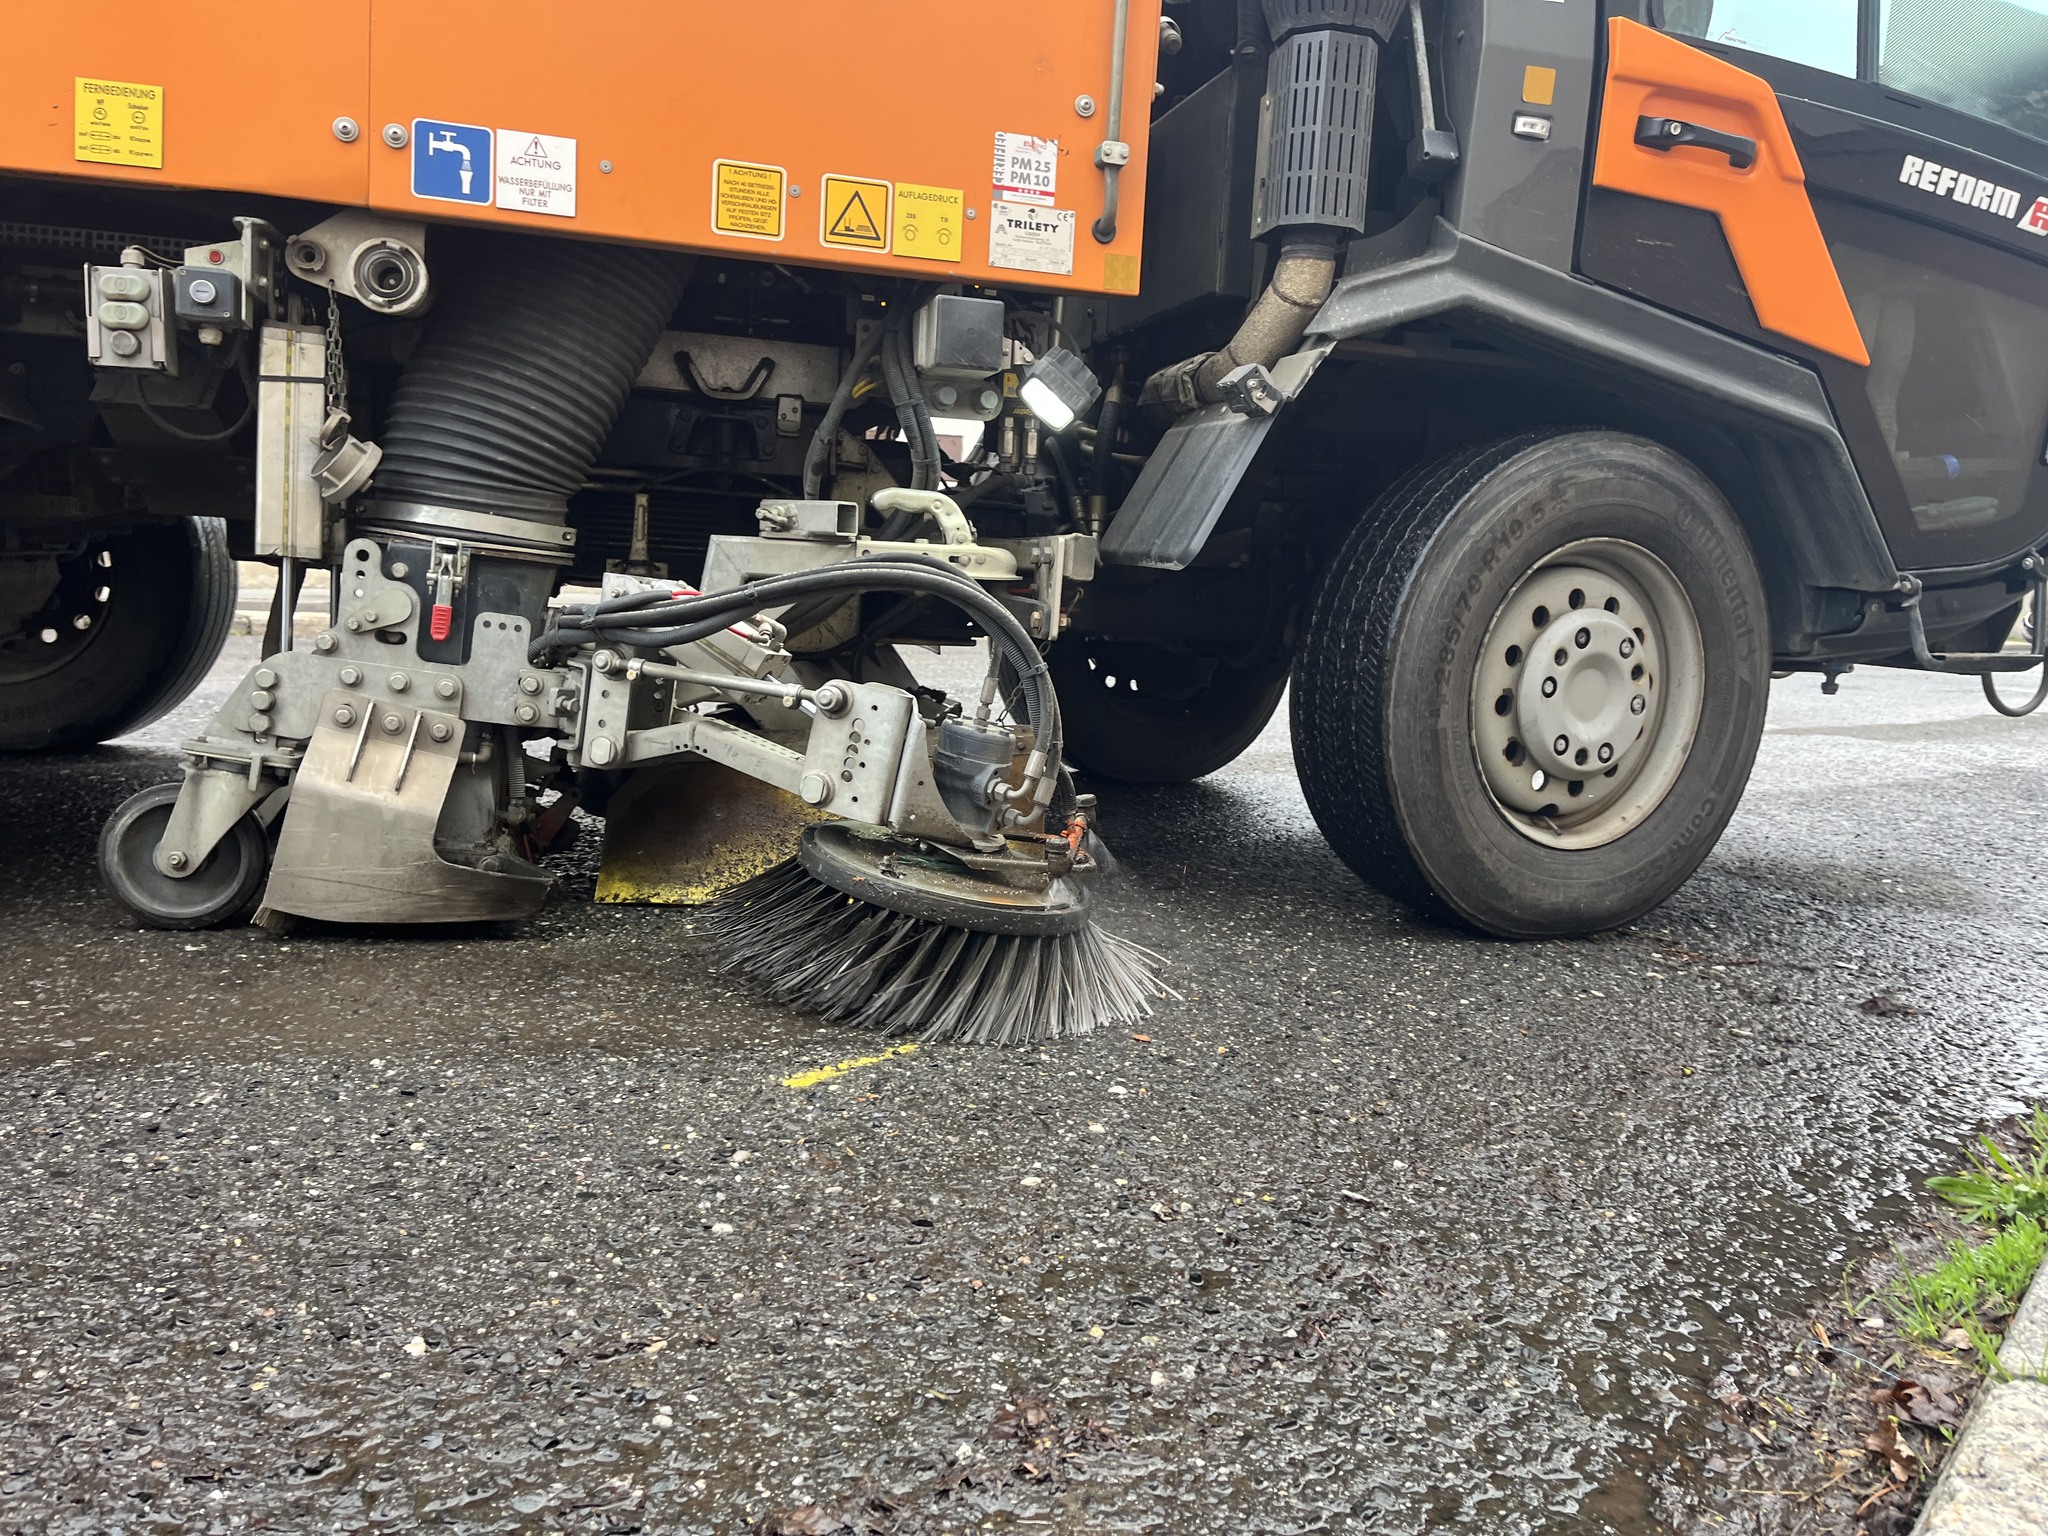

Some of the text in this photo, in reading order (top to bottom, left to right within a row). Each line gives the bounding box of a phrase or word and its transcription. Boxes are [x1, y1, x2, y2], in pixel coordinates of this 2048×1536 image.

[83, 82, 157, 100] FERNBEDIENUNG
[510, 156, 562, 170] ACHTUNG
[1010, 156, 1051, 173] PM 2.5
[732, 169, 768, 179] ACHTUNG
[1010, 170, 1050, 187] PM 10
[498, 175, 573, 193] WASSERBEFÜLLUNG
[1898, 154, 2022, 220] REFORM
[519, 187, 552, 199] NUR MIT
[898, 190, 959, 205] AUFLAGEDRUCK
[521, 197, 549, 208] FILTER
[1007, 218, 1060, 234] TRILETY
